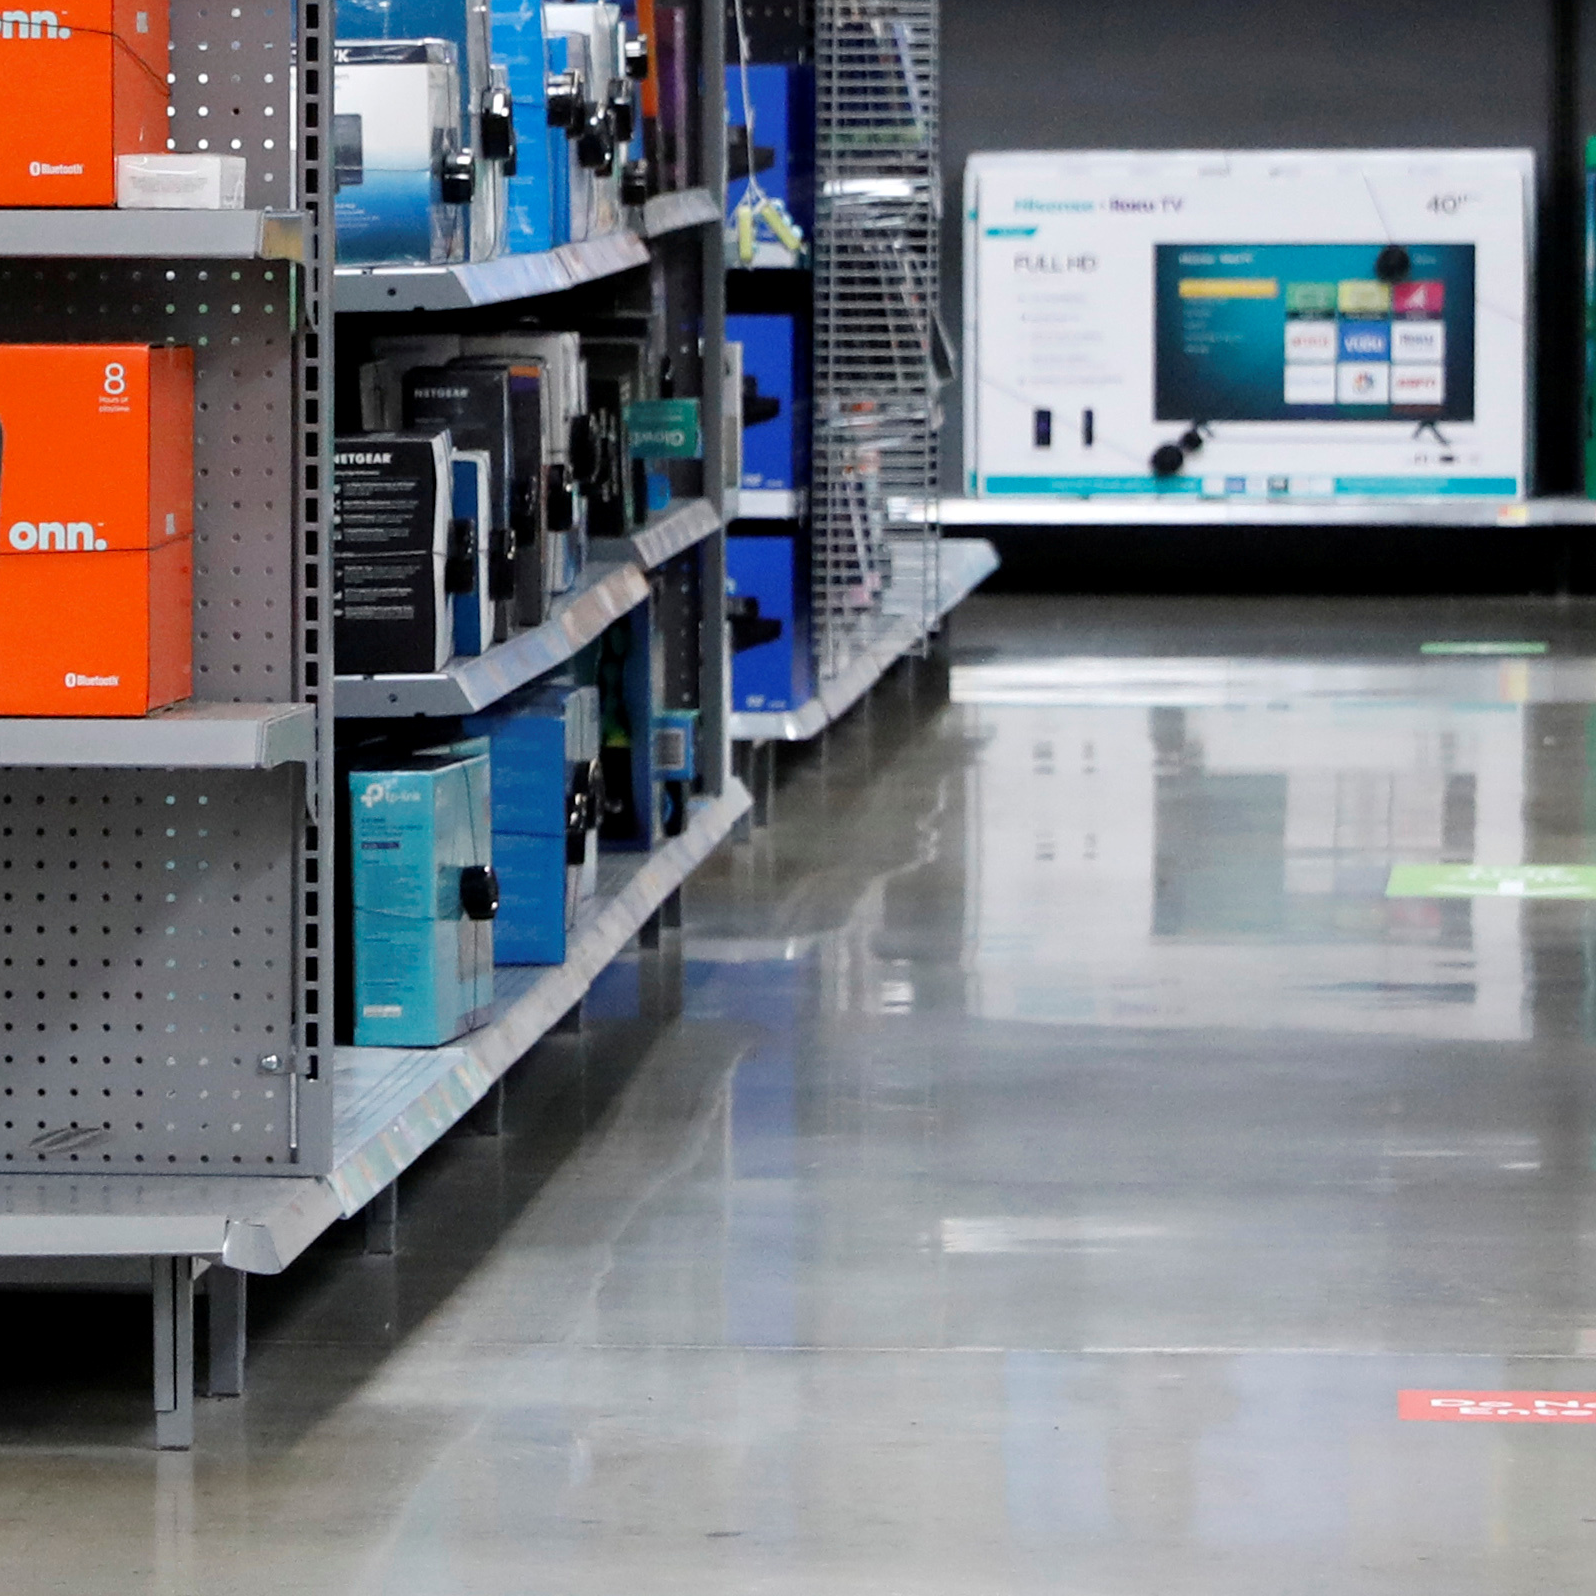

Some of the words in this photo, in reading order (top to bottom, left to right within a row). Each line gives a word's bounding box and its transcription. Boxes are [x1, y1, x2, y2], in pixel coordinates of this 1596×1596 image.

[103, 363, 126, 395] 8
[414, 388, 469, 399] NETGEAR
[334, 453, 392, 466] NETGEAR
[8, 520, 107, 552] onn.
[1431, 1398, 1513, 1408] Do
